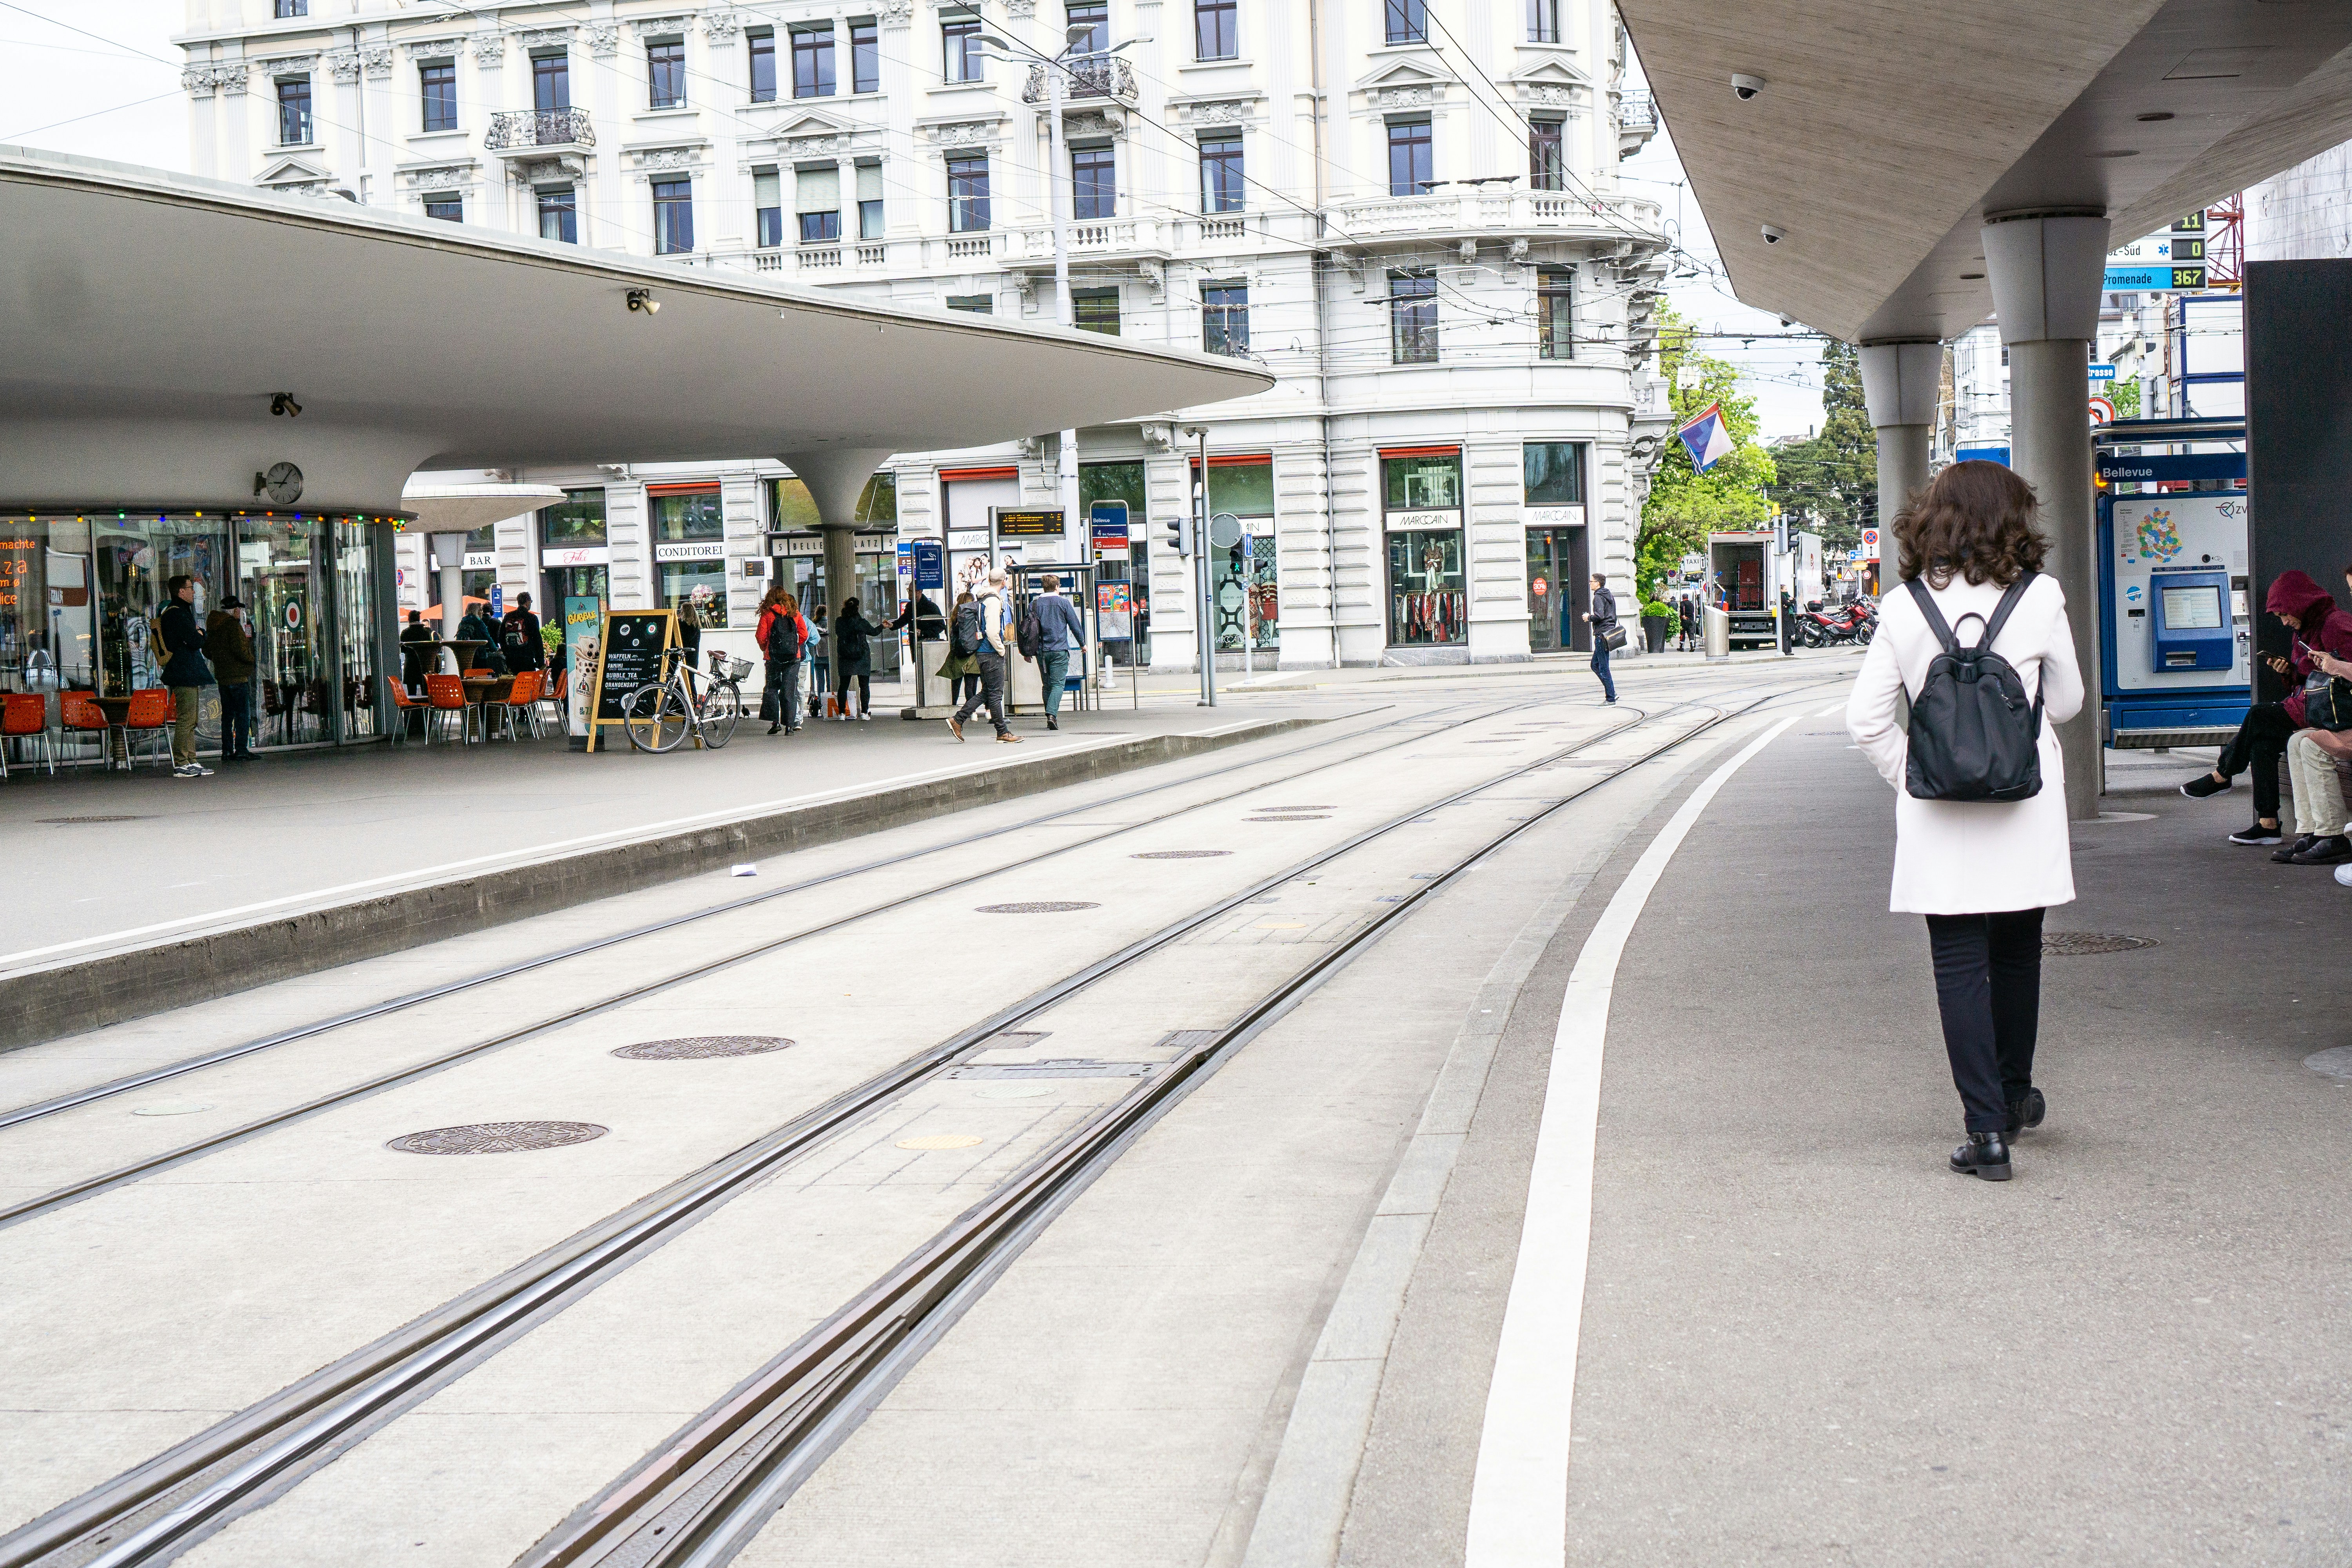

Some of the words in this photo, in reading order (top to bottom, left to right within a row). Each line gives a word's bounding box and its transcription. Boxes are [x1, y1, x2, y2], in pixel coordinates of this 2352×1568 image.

[2182, 214, 2201, 229] 11
[2192, 241, 2201, 256] 0
[2103, 273, 2152, 284] Promenade
[2173, 270, 2201, 285] 367
[2103, 467, 2152, 477] Bellevue
[1400, 515, 1448, 525] MARCCAIN
[1532, 510, 1576, 521] MARCCAIN
[889, 539, 893, 547] 5
[563, 549, 590, 564] Felix
[659, 546, 723, 557] CONDITOREI
[470, 556, 491, 565] BAR
[567, 610, 597, 625] BUBBLE
